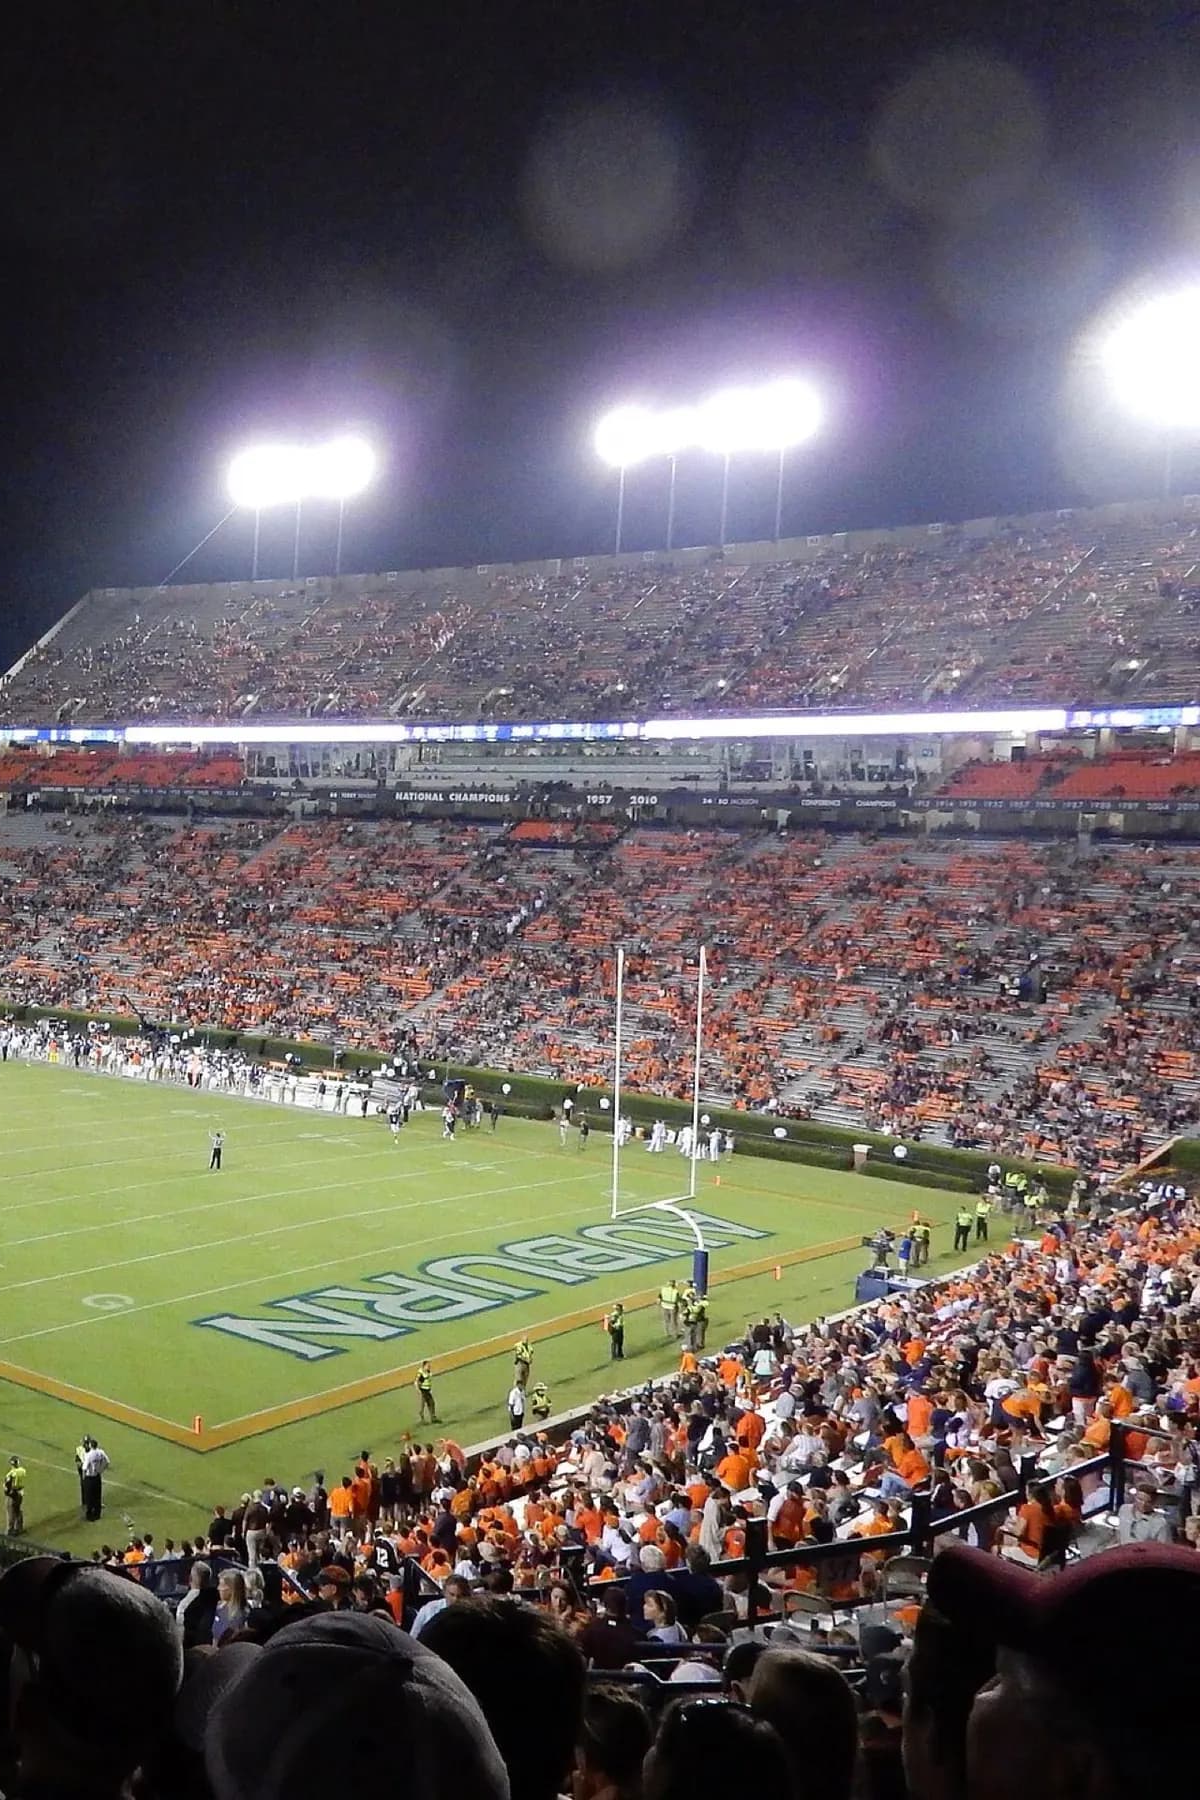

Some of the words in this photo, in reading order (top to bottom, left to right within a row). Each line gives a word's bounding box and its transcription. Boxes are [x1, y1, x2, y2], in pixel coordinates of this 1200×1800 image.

[395, 791, 444, 802] NATIONAL
[449, 792, 510, 803] CHAMPIONS
[586, 795, 613, 805] 1957
[629, 795, 658, 805] 2010
[189, 1206, 777, 1361] AUBURN
[376, 1547, 389, 1567] 12
